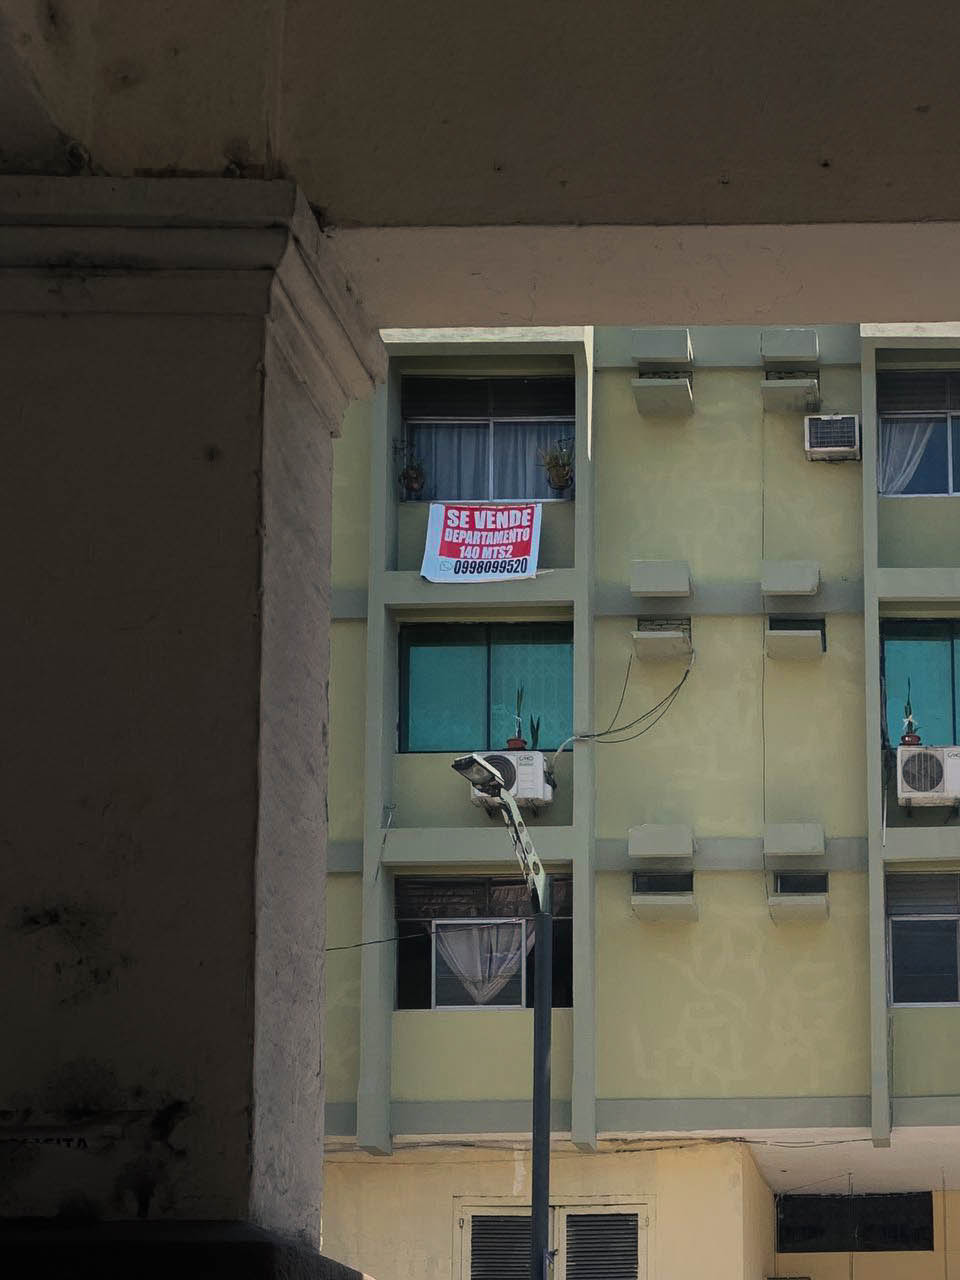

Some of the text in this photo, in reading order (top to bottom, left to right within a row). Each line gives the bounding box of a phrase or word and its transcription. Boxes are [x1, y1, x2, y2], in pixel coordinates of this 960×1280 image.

[447, 508, 531, 529] SE VENDE
[445, 528, 530, 545] DEPARTAMENTO
[459, 544, 513, 559] 140 MTS2
[453, 558, 528, 575] 0998099520
